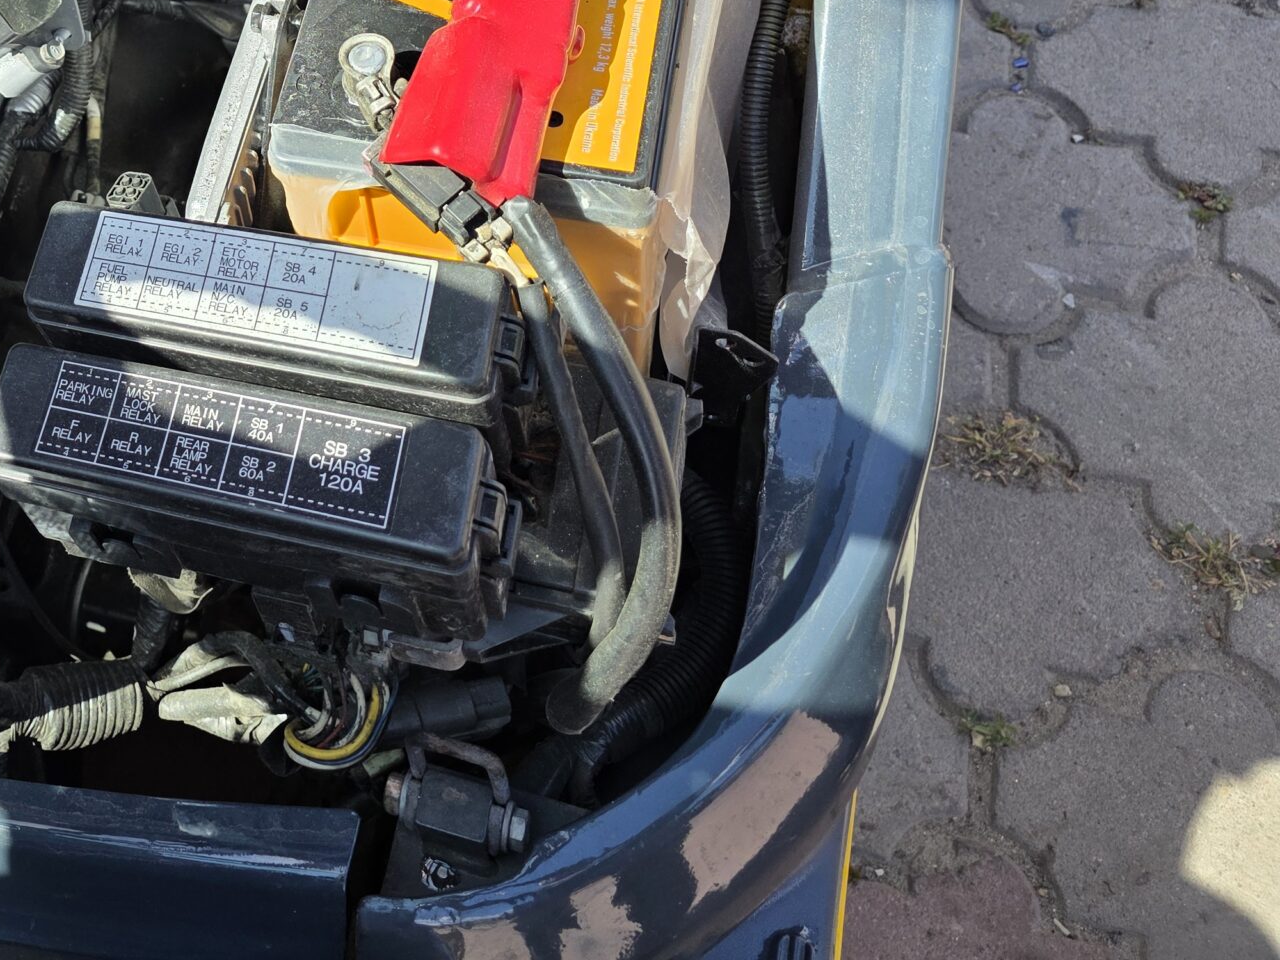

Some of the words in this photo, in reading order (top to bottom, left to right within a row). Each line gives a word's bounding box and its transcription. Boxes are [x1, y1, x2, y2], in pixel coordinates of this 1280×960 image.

[600, 13, 615, 39] weight
[597, 43, 612, 59] 12,3
[593, 62, 609, 72] kg
[590, 89, 604, 110] Made
[582, 122, 599, 153] Ukraine
[107, 234, 129, 244] EGI
[105, 244, 142, 256] RELAY
[163, 242, 186, 254] EGI
[193, 248, 202, 256] 2
[222, 247, 246, 259] ETC
[160, 253, 199, 266] RELAY
[220, 257, 260, 271] MOTOR
[100, 262, 128, 276] FUEL
[218, 266, 257, 281] RELAY
[284, 262, 301, 274] SB
[308, 266, 316, 276] 4
[96, 272, 127, 283] PUMP
[146, 275, 198, 292] NEUTRAL
[282, 272, 306, 284] 20A
[94, 282, 132, 295] RELAY
[144, 286, 182, 299] RELAY
[213, 282, 246, 296] MAIN
[211, 292, 235, 304] N/C
[276, 297, 292, 309] SB
[300, 302, 309, 312] 5
[208, 300, 248, 314] RELAY
[273, 308, 298, 320] 20A
[58, 379, 114, 399] PARKING
[126, 387, 159, 402] MAST
[56, 389, 96, 406] RELAY
[123, 398, 156, 412] LOCK
[184, 404, 219, 420] MAIN
[120, 408, 162, 424] RELAY
[182, 414, 224, 432] RELAY
[70, 420, 80, 430] F
[250, 417, 269, 430] SB
[276, 423, 284, 434] 1
[52, 428, 92, 444] RELAY
[130, 432, 140, 442] R
[248, 429, 274, 442] 40A
[111, 439, 152, 456] RELAY
[176, 436, 210, 452] REAR
[172, 447, 208, 460] LAMP
[324, 440, 348, 458] SB
[358, 448, 372, 463] 3
[170, 458, 212, 475] RELAY
[242, 455, 260, 468] SB
[266, 462, 276, 473] 2
[309, 454, 381, 482] CHARGE
[238, 467, 264, 481] 60A
[320, 473, 364, 495] 120A
